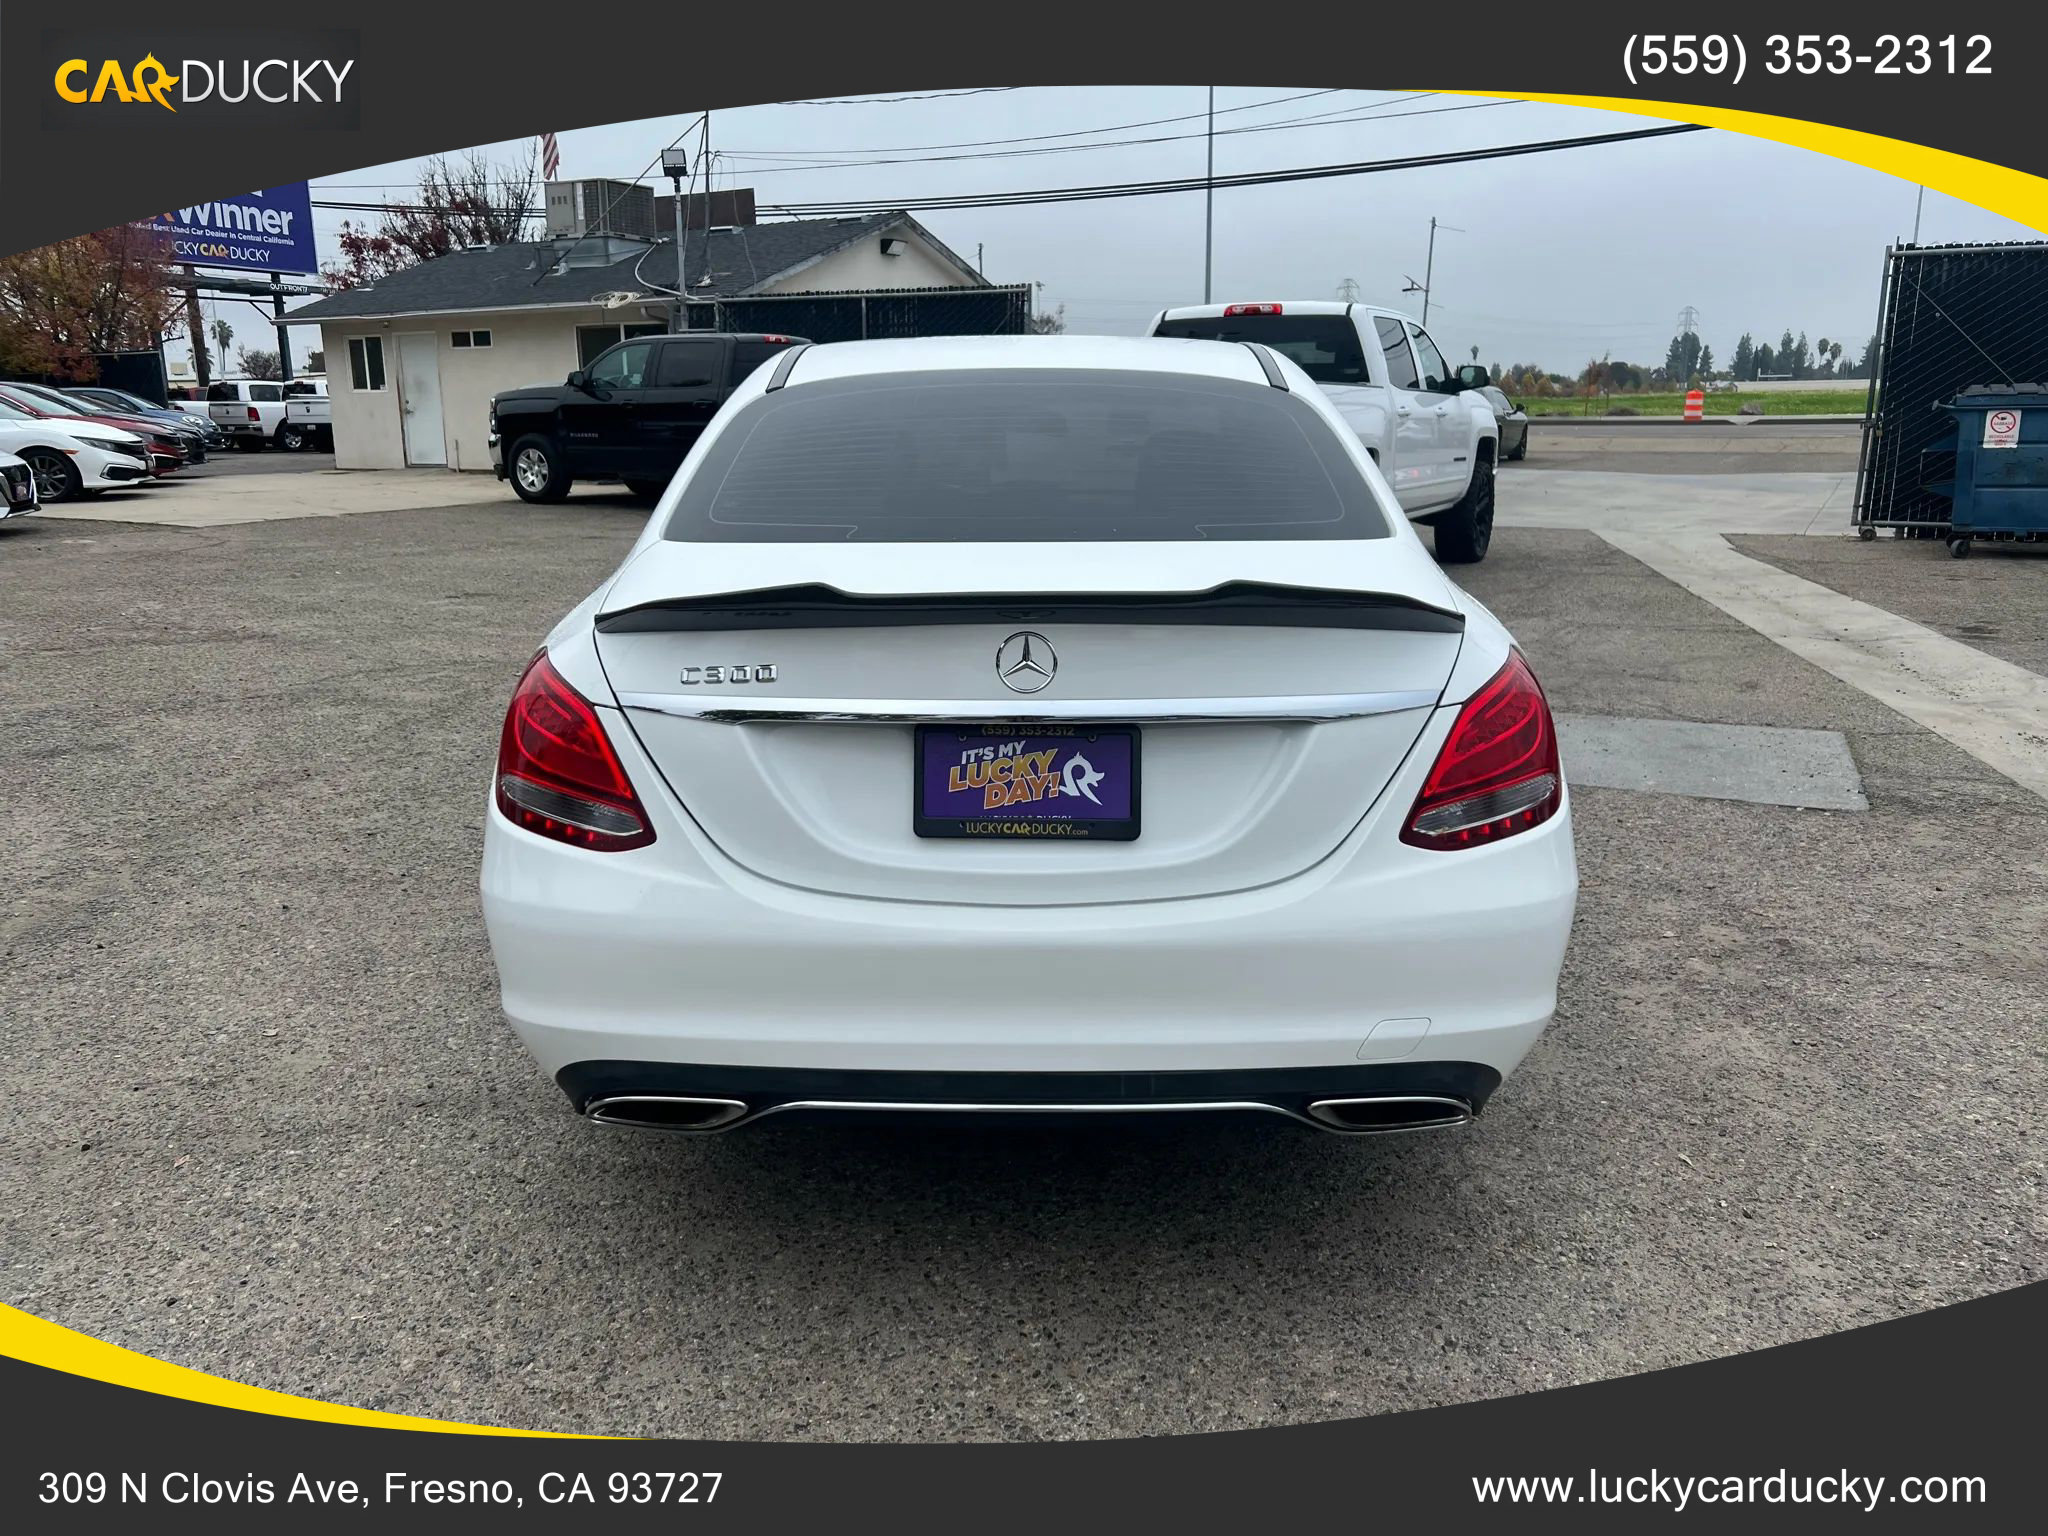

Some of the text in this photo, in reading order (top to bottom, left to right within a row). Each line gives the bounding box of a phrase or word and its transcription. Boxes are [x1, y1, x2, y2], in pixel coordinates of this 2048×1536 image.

[178, 200, 293, 236] Winner
[153, 223, 170, 232] Best
[171, 225, 190, 234] Used
[191, 227, 203, 236] Car
[205, 229, 228, 239] Dealer
[229, 231, 237, 239] In
[237, 232, 262, 242] Central
[263, 235, 295, 246] California
[680, 663, 779, 685] C300
[981, 726, 1075, 737] (559) 353-2312
[998, 740, 1026, 759] MY
[948, 748, 1058, 792] LUCKY
[984, 772, 1060, 810] DAY!
